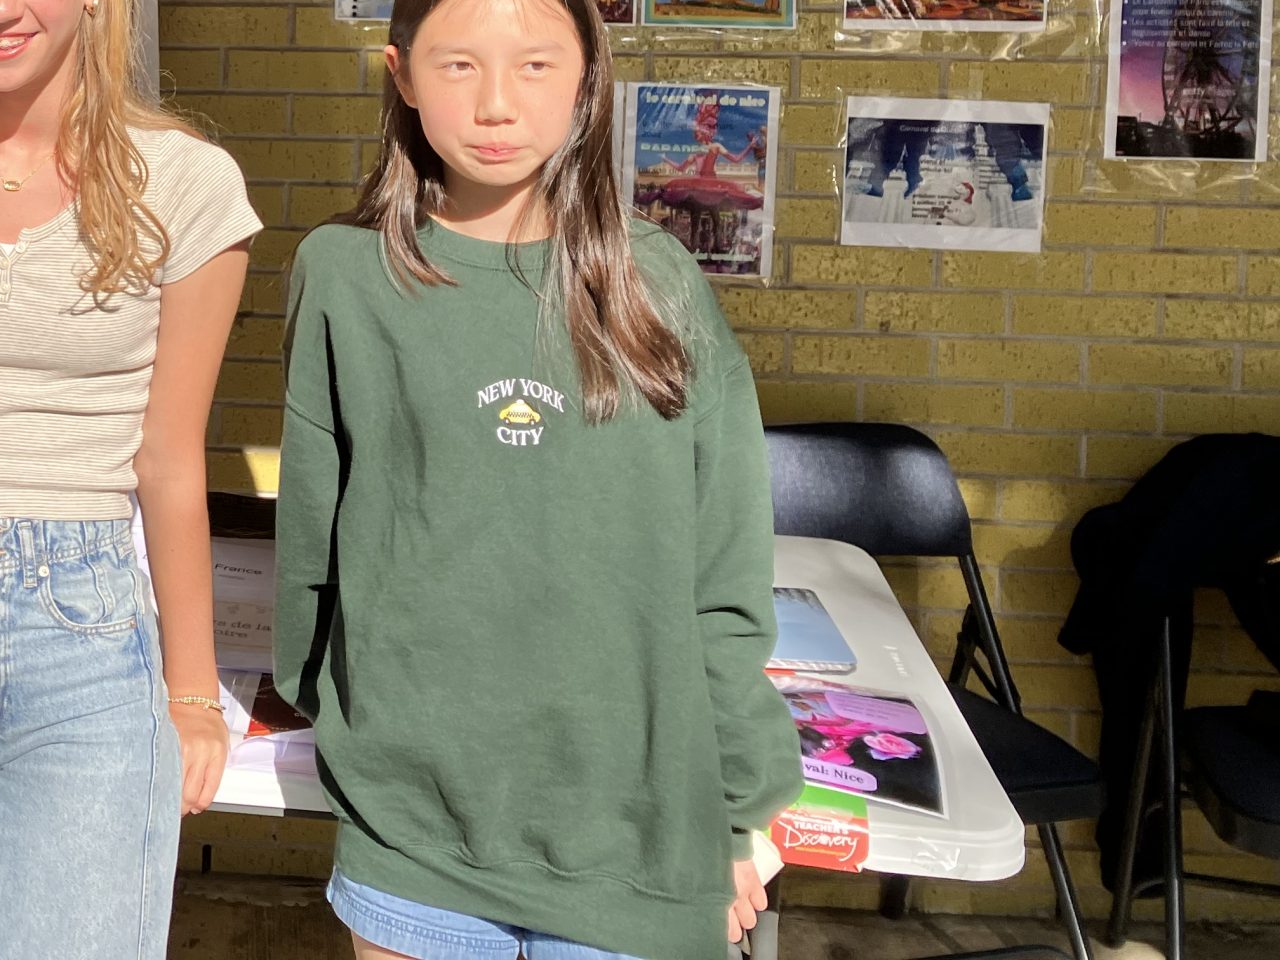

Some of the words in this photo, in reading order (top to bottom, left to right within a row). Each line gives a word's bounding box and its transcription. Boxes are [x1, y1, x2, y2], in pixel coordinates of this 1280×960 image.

[477, 378, 517, 409] NEW
[519, 378, 565, 413] YORK
[496, 426, 545, 446] CITY
[805, 763, 830, 776] val:
[834, 768, 865, 784] Nice
[777, 820, 858, 862] Discovery
